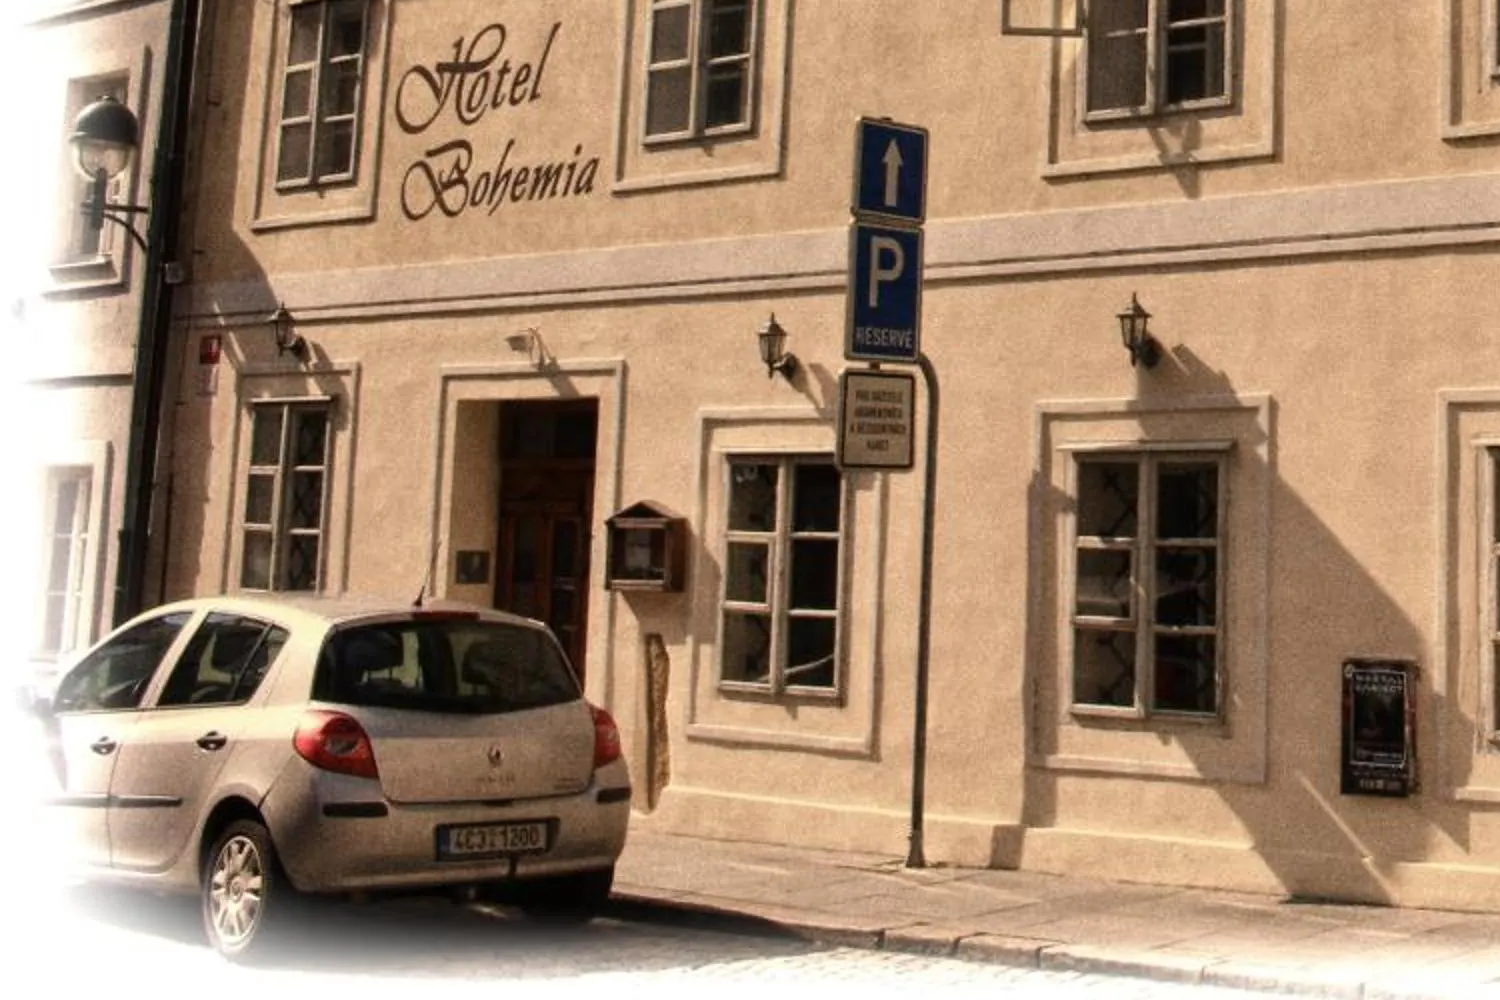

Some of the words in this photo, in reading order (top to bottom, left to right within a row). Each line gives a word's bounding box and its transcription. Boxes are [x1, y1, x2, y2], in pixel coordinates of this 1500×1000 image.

[395, 21, 562, 135] Hotel
[401, 138, 600, 221] Bohemia
[868, 236, 905, 308] P
